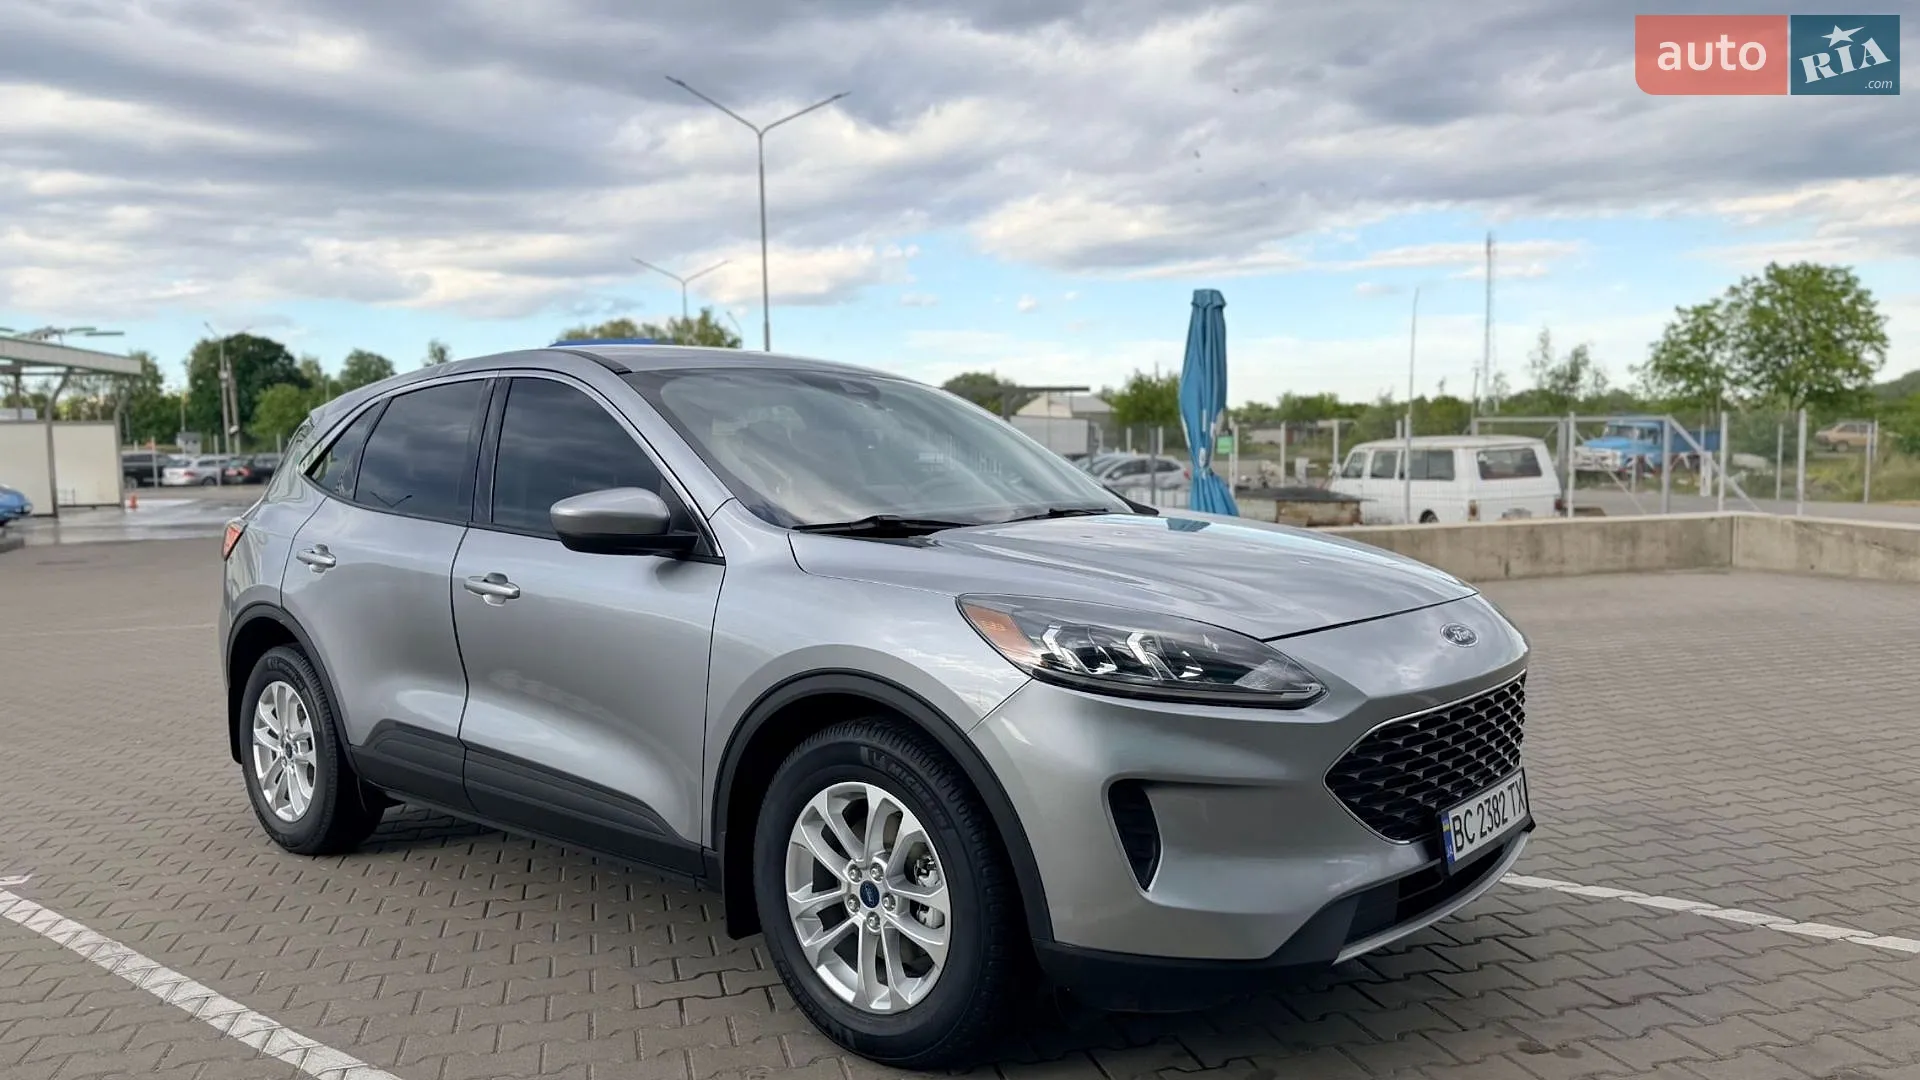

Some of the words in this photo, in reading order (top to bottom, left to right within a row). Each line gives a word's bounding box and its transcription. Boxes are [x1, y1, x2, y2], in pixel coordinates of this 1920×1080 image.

[1451, 808, 1476, 853] BC
[1477, 790, 1508, 838] 2382
[1507, 777, 1525, 817] TX
